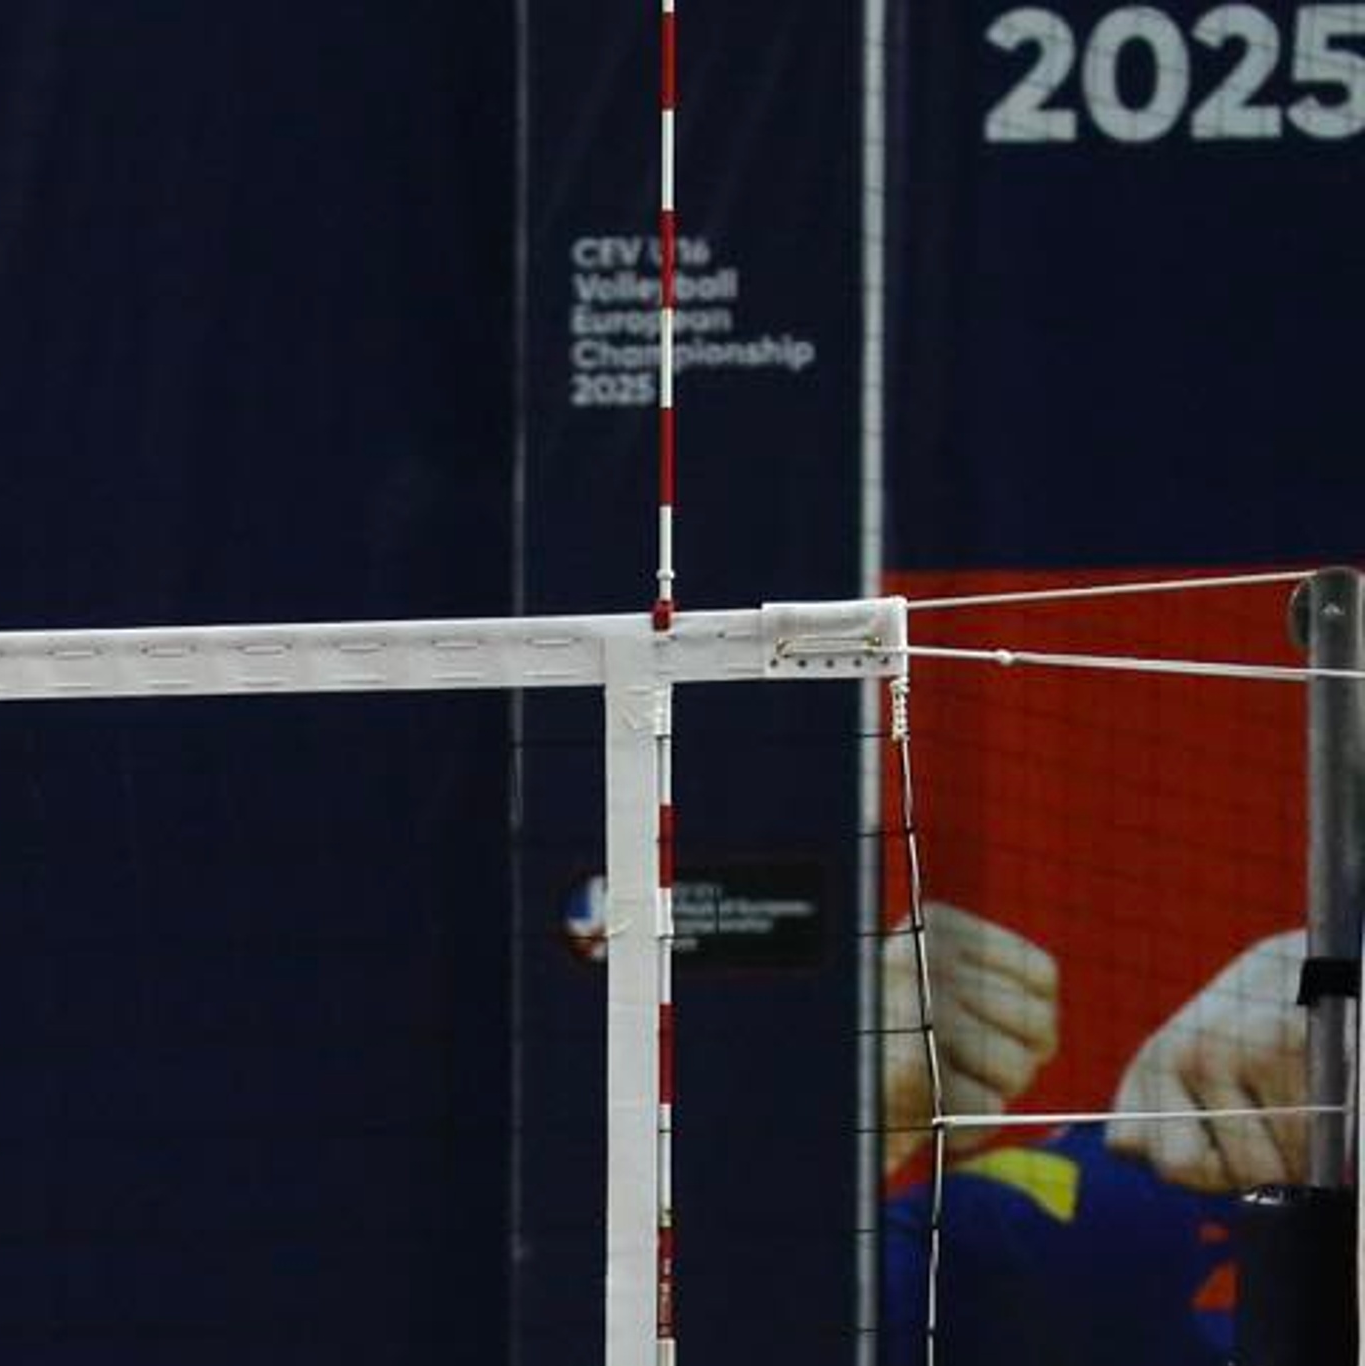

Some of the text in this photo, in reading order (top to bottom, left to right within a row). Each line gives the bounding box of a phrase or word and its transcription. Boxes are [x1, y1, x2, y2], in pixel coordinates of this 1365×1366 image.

[984, 3, 1365, 143] 2025
[571, 238, 640, 267] CEV
[571, 373, 655, 405] 2025
